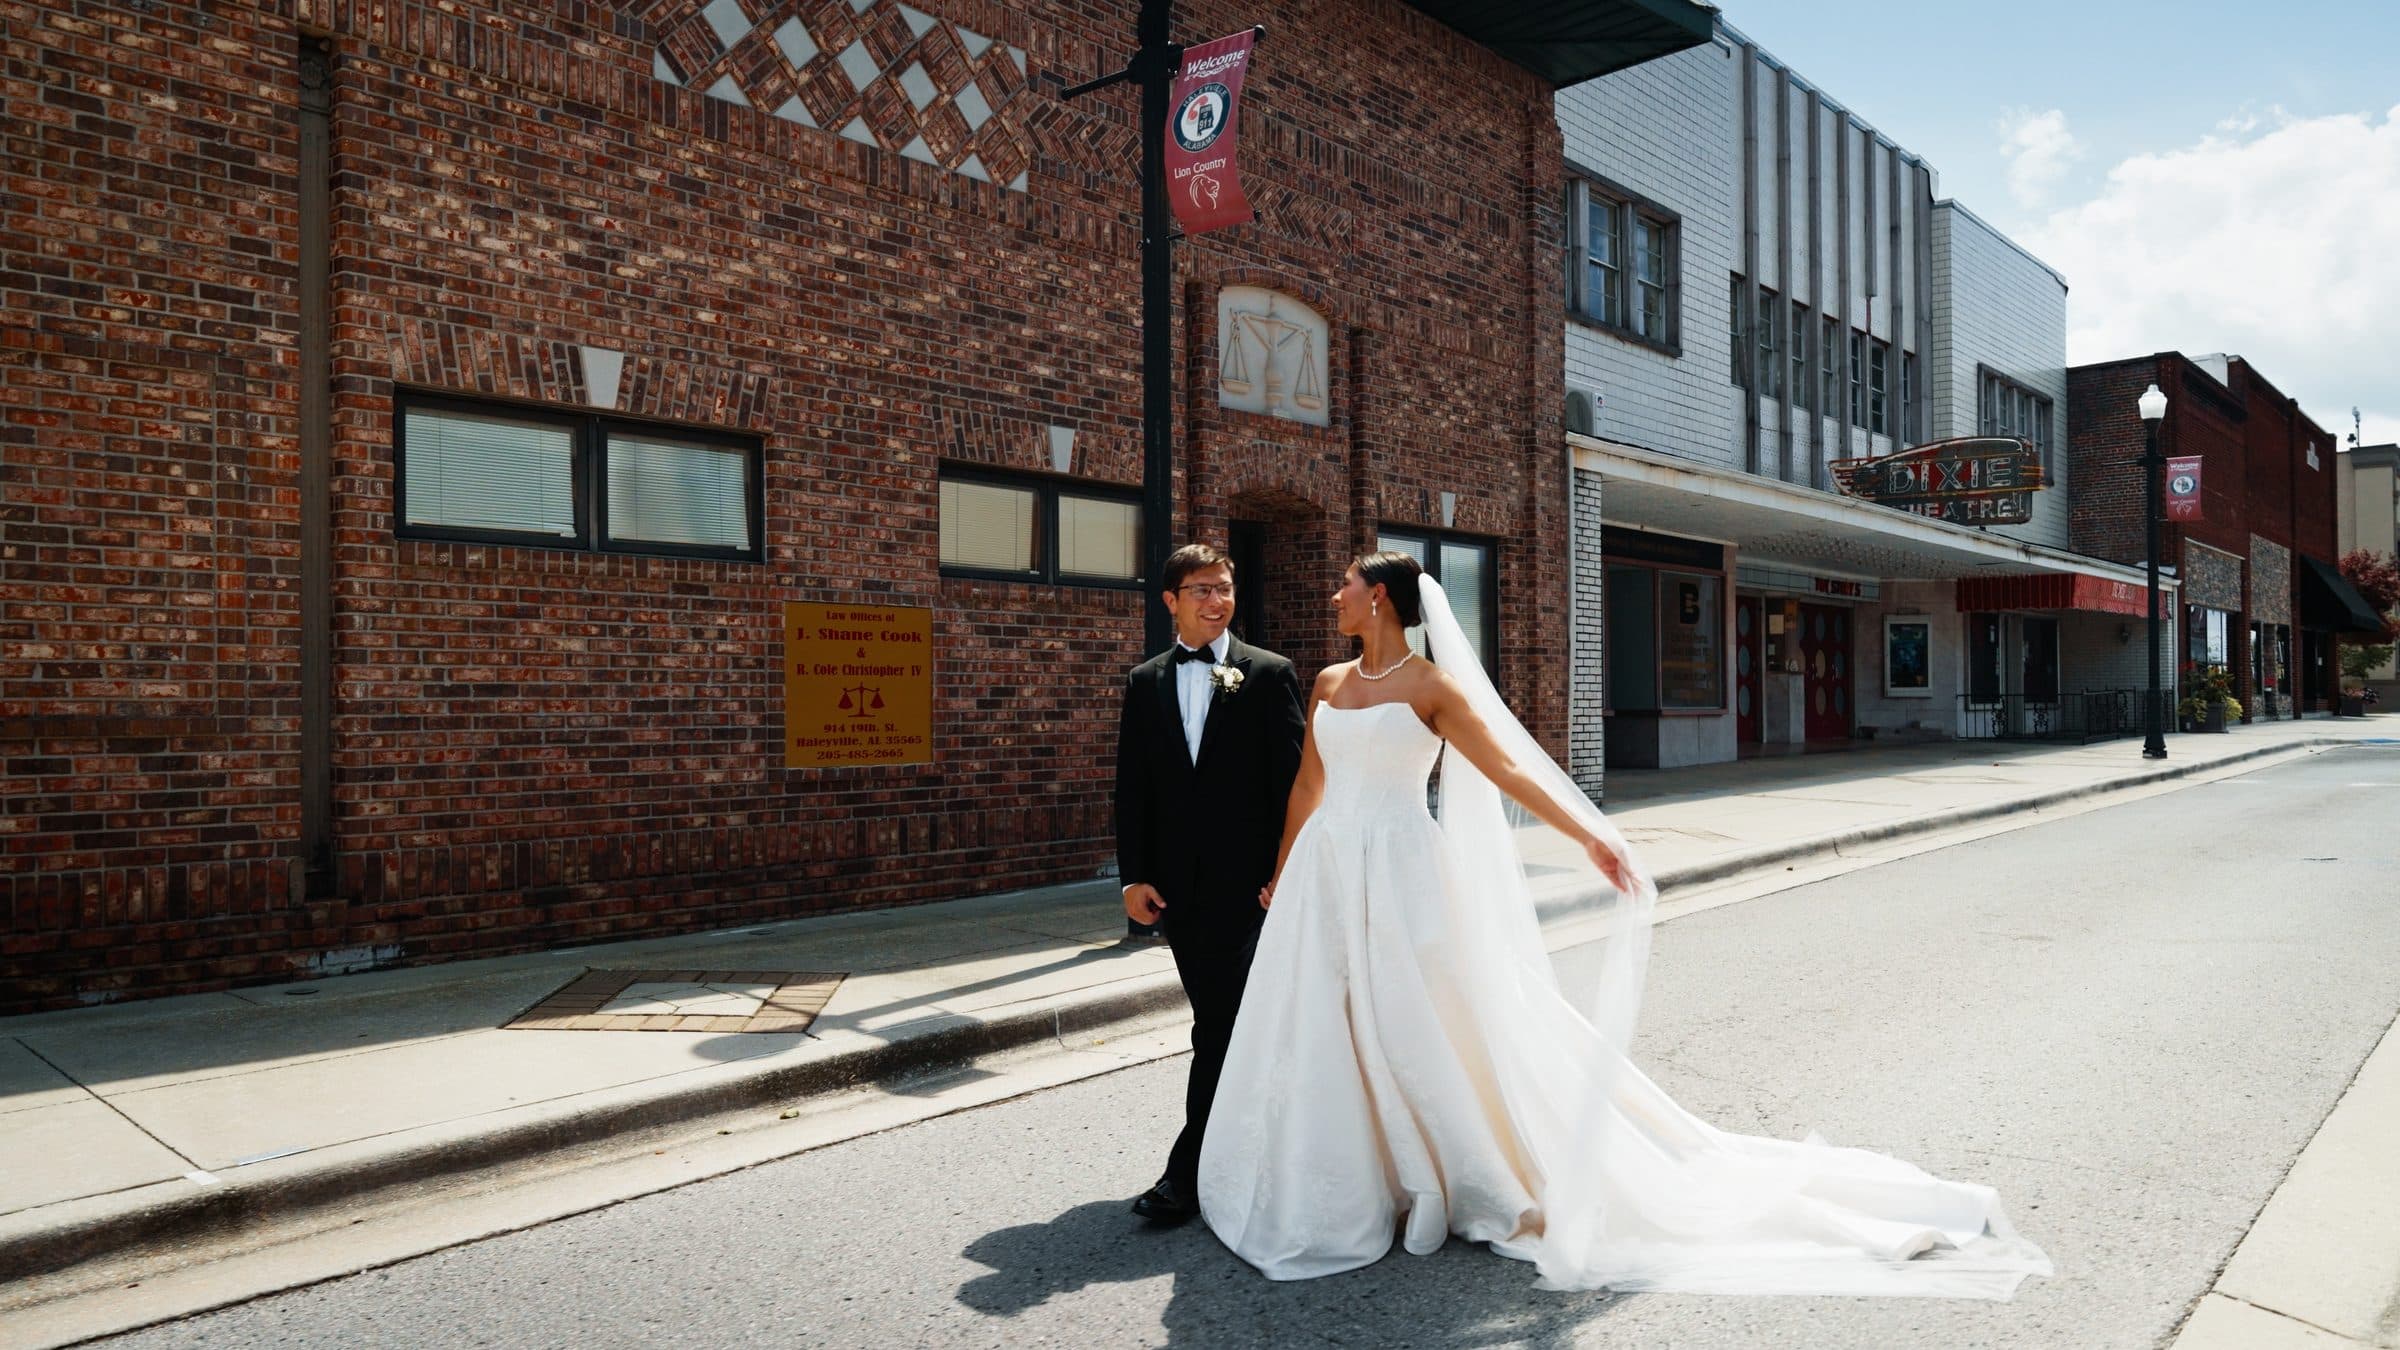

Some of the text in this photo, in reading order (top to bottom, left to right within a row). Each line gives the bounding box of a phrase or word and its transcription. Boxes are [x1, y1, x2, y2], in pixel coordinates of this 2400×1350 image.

[1187, 49, 1245, 75] Welcome
[1183, 134, 1217, 150] ALABAMA
[1174, 157, 1227, 179] Lion Country
[1889, 457, 2012, 494] DIXIE
[826, 611, 895, 622] Law Offices of
[796, 627, 923, 644] J. Shane Cook
[856, 647, 867, 659] &
[796, 663, 922, 677] R. Cole Christopher IV
[823, 722, 898, 734] 914 19th. St.
[796, 735, 923, 748] Haleyville, AL 35565
[816, 748, 904, 761] 205-485-2665
